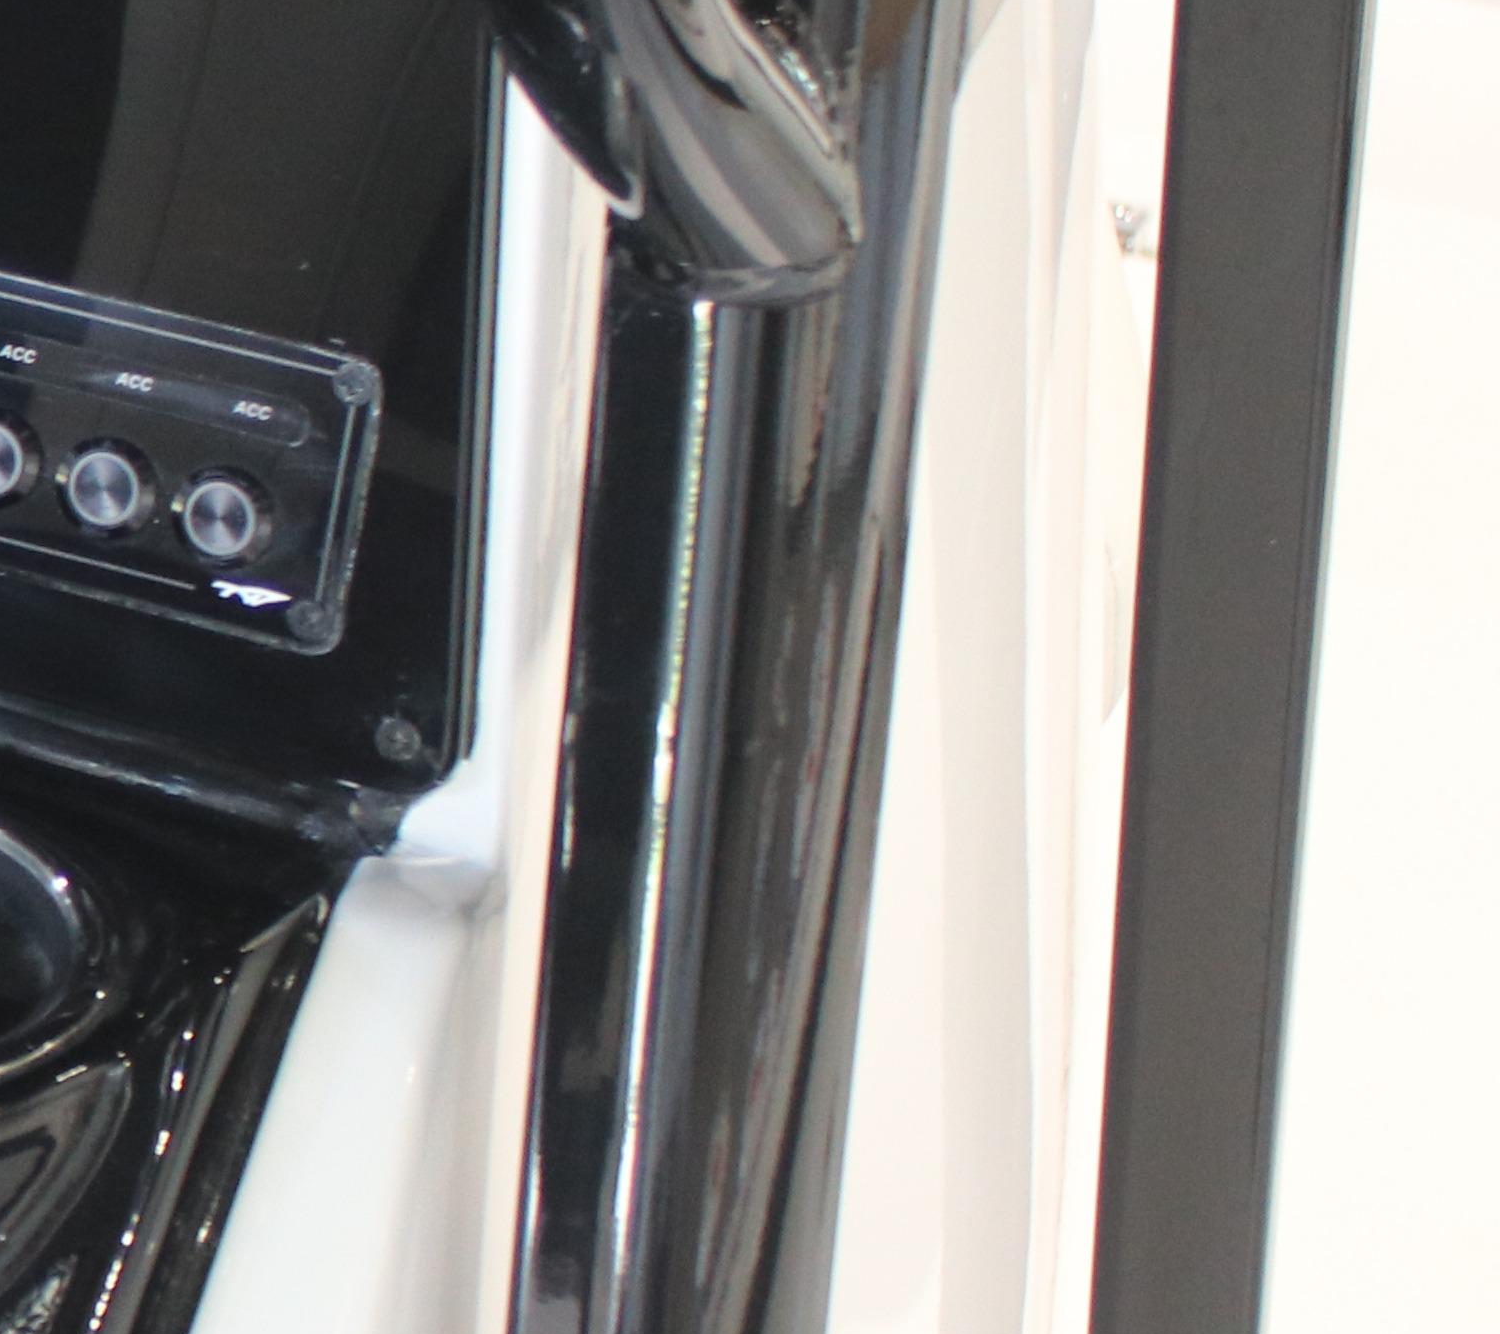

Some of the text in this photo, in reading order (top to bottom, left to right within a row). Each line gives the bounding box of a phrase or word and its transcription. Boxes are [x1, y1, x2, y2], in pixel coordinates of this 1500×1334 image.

[0, 344, 37, 365] ACC
[115, 371, 155, 392] ACC
[232, 400, 274, 421] ACC
